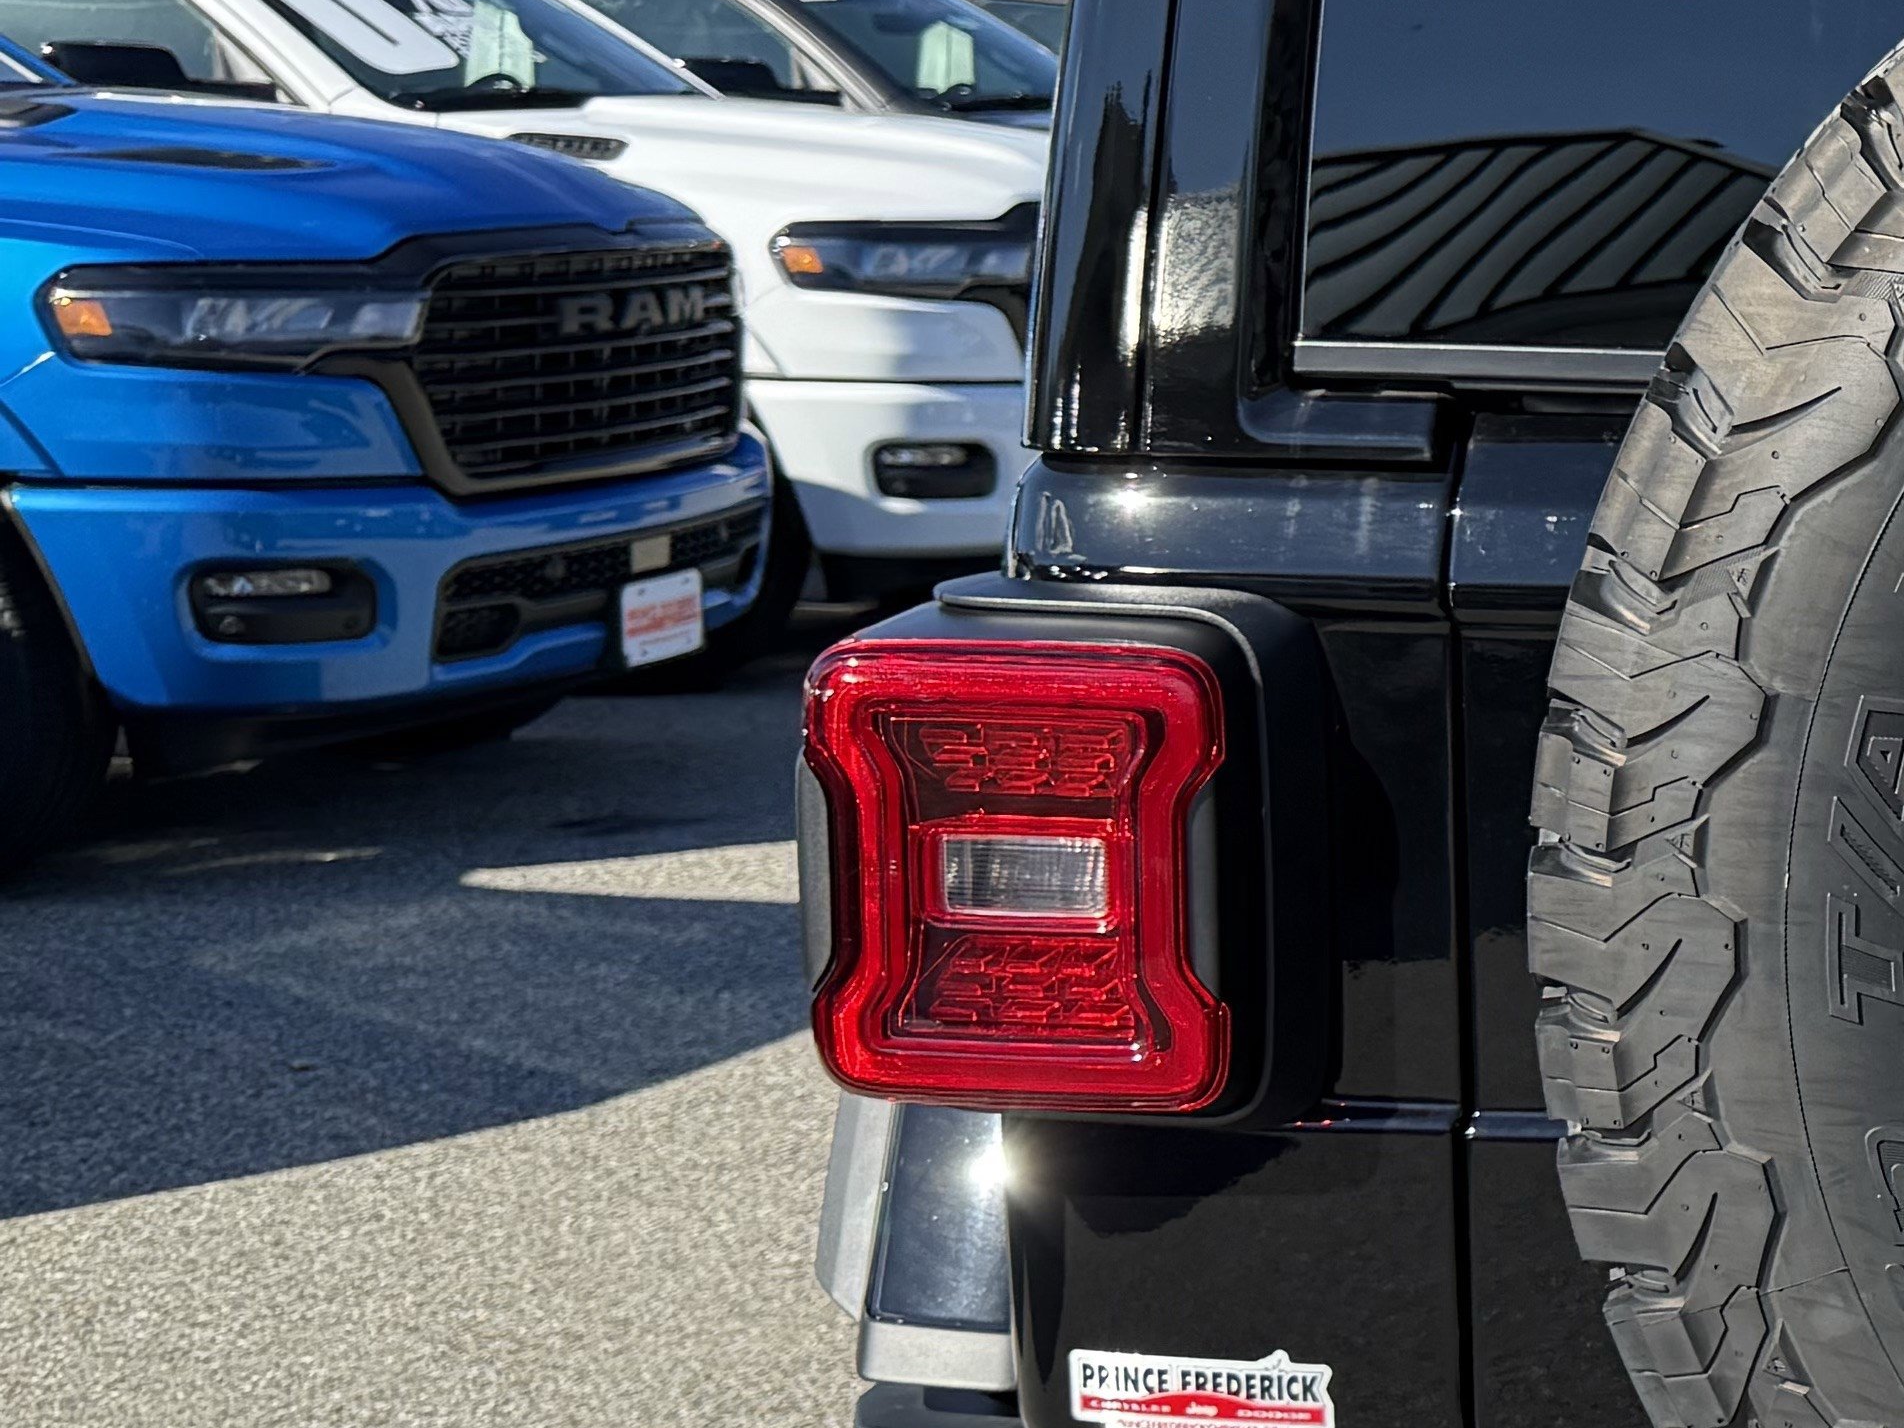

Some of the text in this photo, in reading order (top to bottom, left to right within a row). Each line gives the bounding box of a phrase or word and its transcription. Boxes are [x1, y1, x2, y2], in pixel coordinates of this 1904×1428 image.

[561, 286, 704, 335] RAM
[1082, 1362, 1321, 1403] PRINCE FREDERICK
